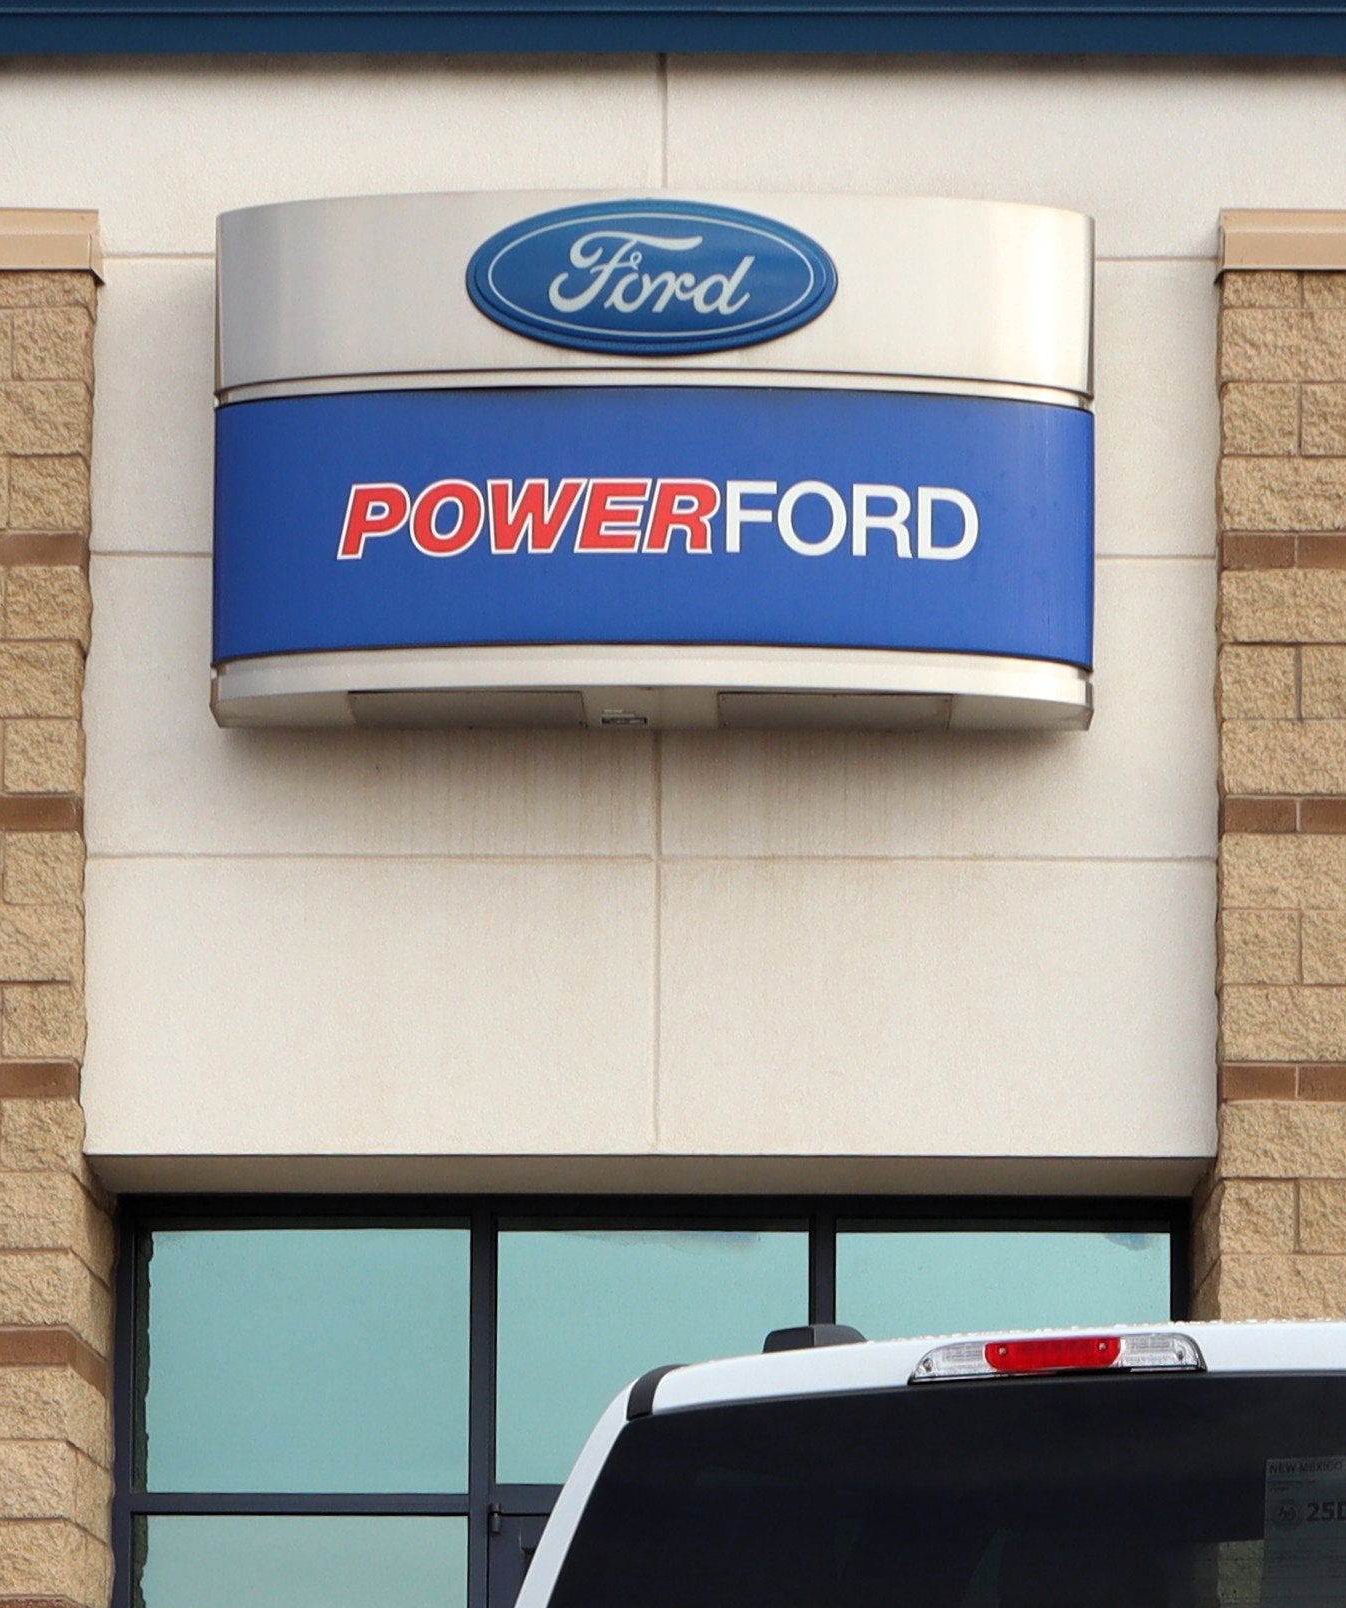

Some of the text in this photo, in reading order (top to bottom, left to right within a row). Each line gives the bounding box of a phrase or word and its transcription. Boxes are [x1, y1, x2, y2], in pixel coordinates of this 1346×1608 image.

[547, 229, 754, 316] Ford
[336, 477, 980, 561] POWERFORD
[1269, 1462, 1297, 1473] NEW
[1299, 1461, 1342, 1472] MEXICO
